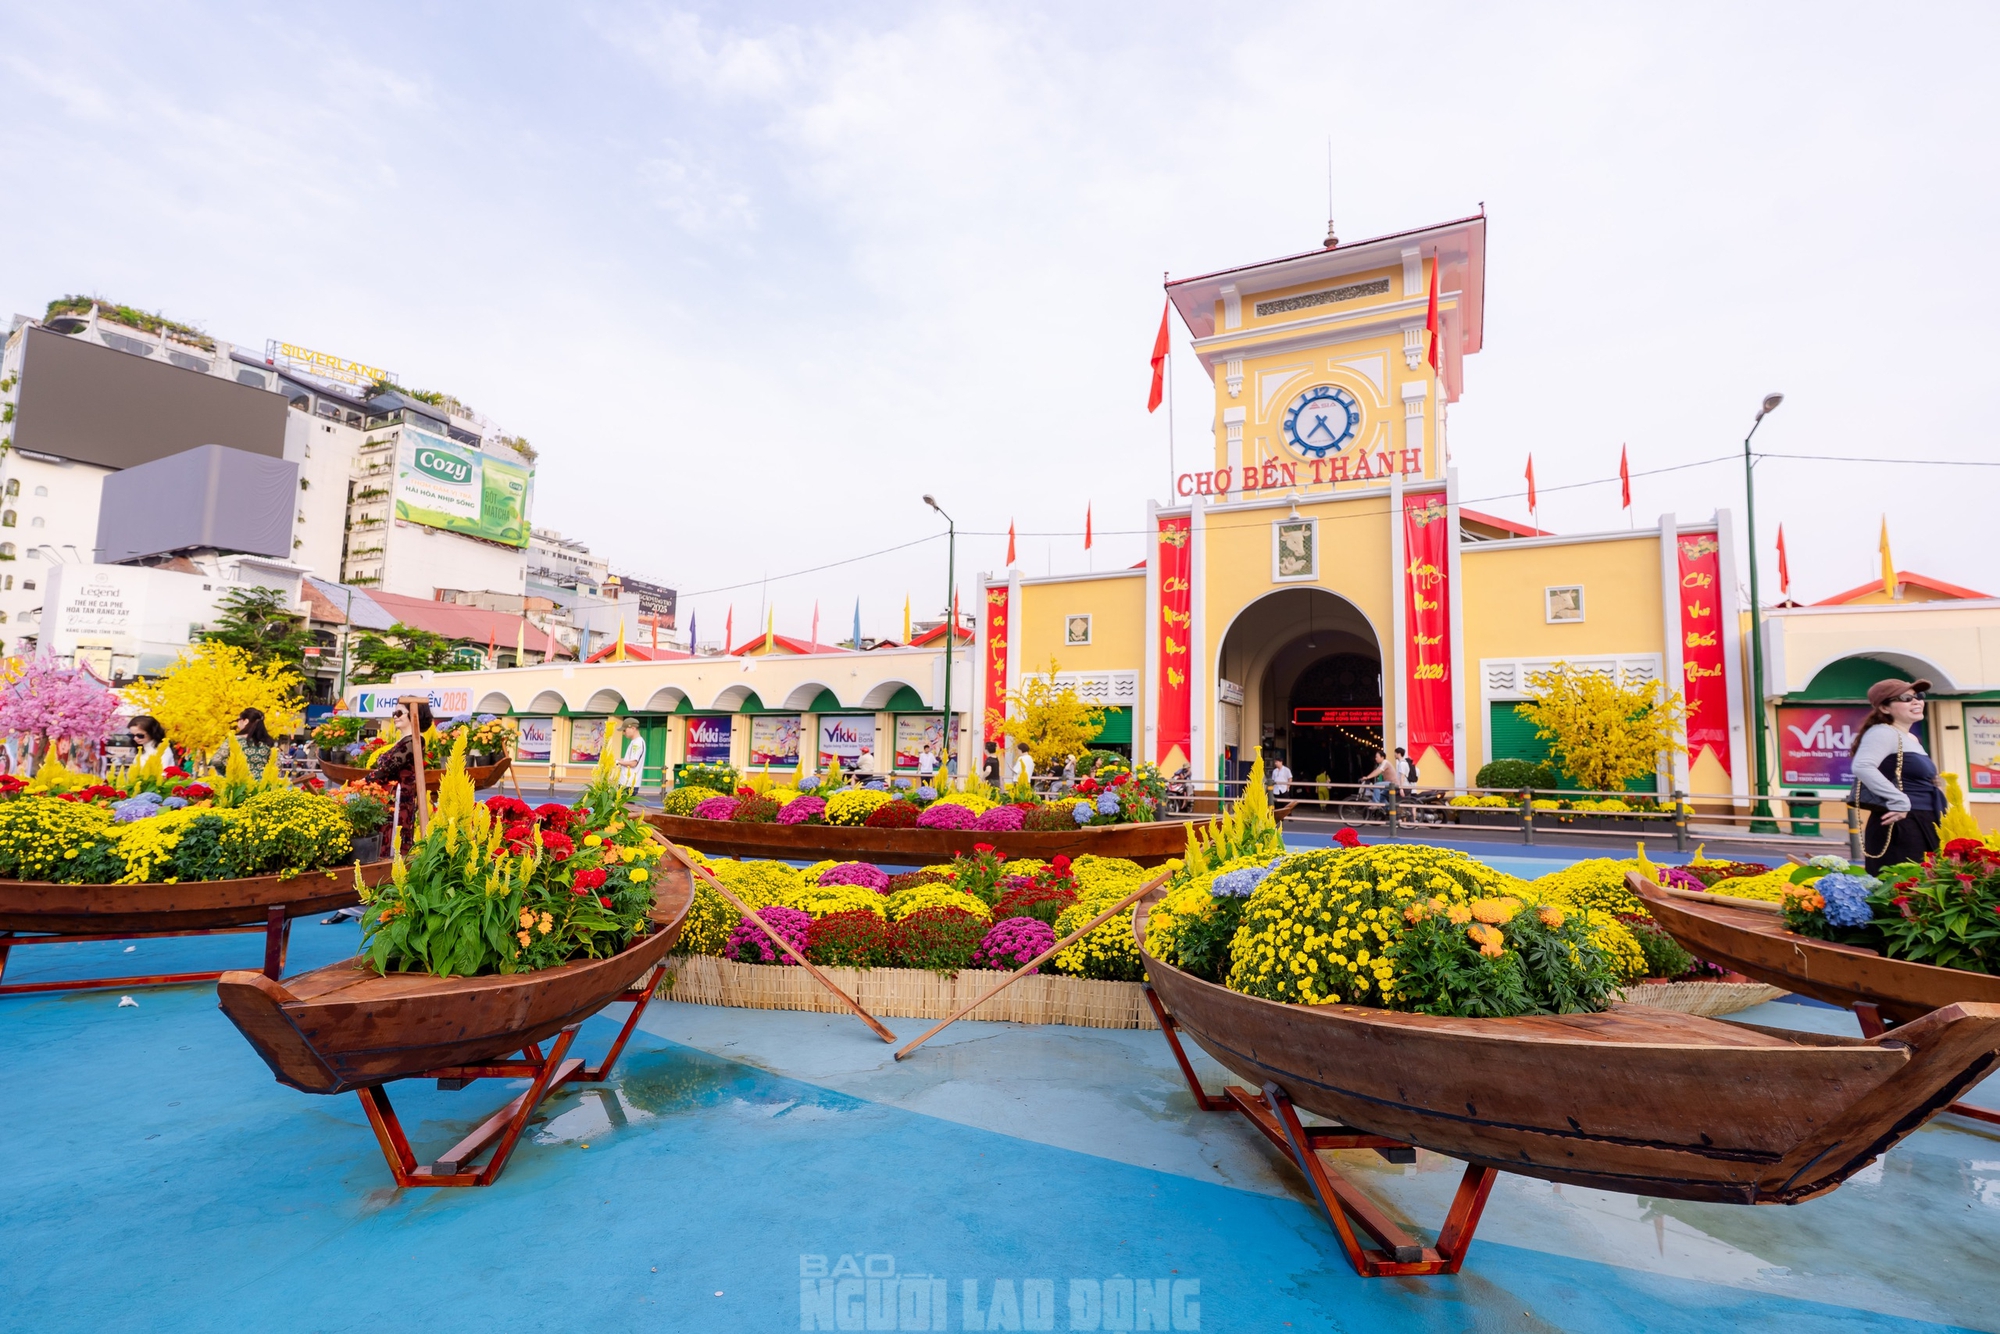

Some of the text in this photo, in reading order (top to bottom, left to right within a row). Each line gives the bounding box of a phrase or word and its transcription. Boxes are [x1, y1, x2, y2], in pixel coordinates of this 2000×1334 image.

[281, 342, 386, 380] SILVERLAND
[1313, 386, 1330, 398] 12
[420, 451, 467, 480] Cozy
[1177, 448, 1422, 496] CHỢ BẾN THÀNH
[484, 504, 510, 522] MATCHA
[1406, 556, 1446, 590] Happy
[1682, 572, 1712, 588] Chợ
[80, 586, 120, 598] Legend
[1163, 576, 1189, 592] Chúc
[652, 603, 668, 614] 2025
[1688, 600, 1711, 618] Vui
[1414, 662, 1444, 679] 2026
[1684, 661, 1722, 683] Thành
[442, 692, 467, 712] 2026
[522, 723, 544, 741] Vikki
[690, 721, 719, 742] Vikki
[824, 720, 857, 742] Vikki
[1787, 714, 1860, 749] Vikk
[1789, 750, 1811, 758] Ngân
[1812, 750, 1833, 758] hàng
